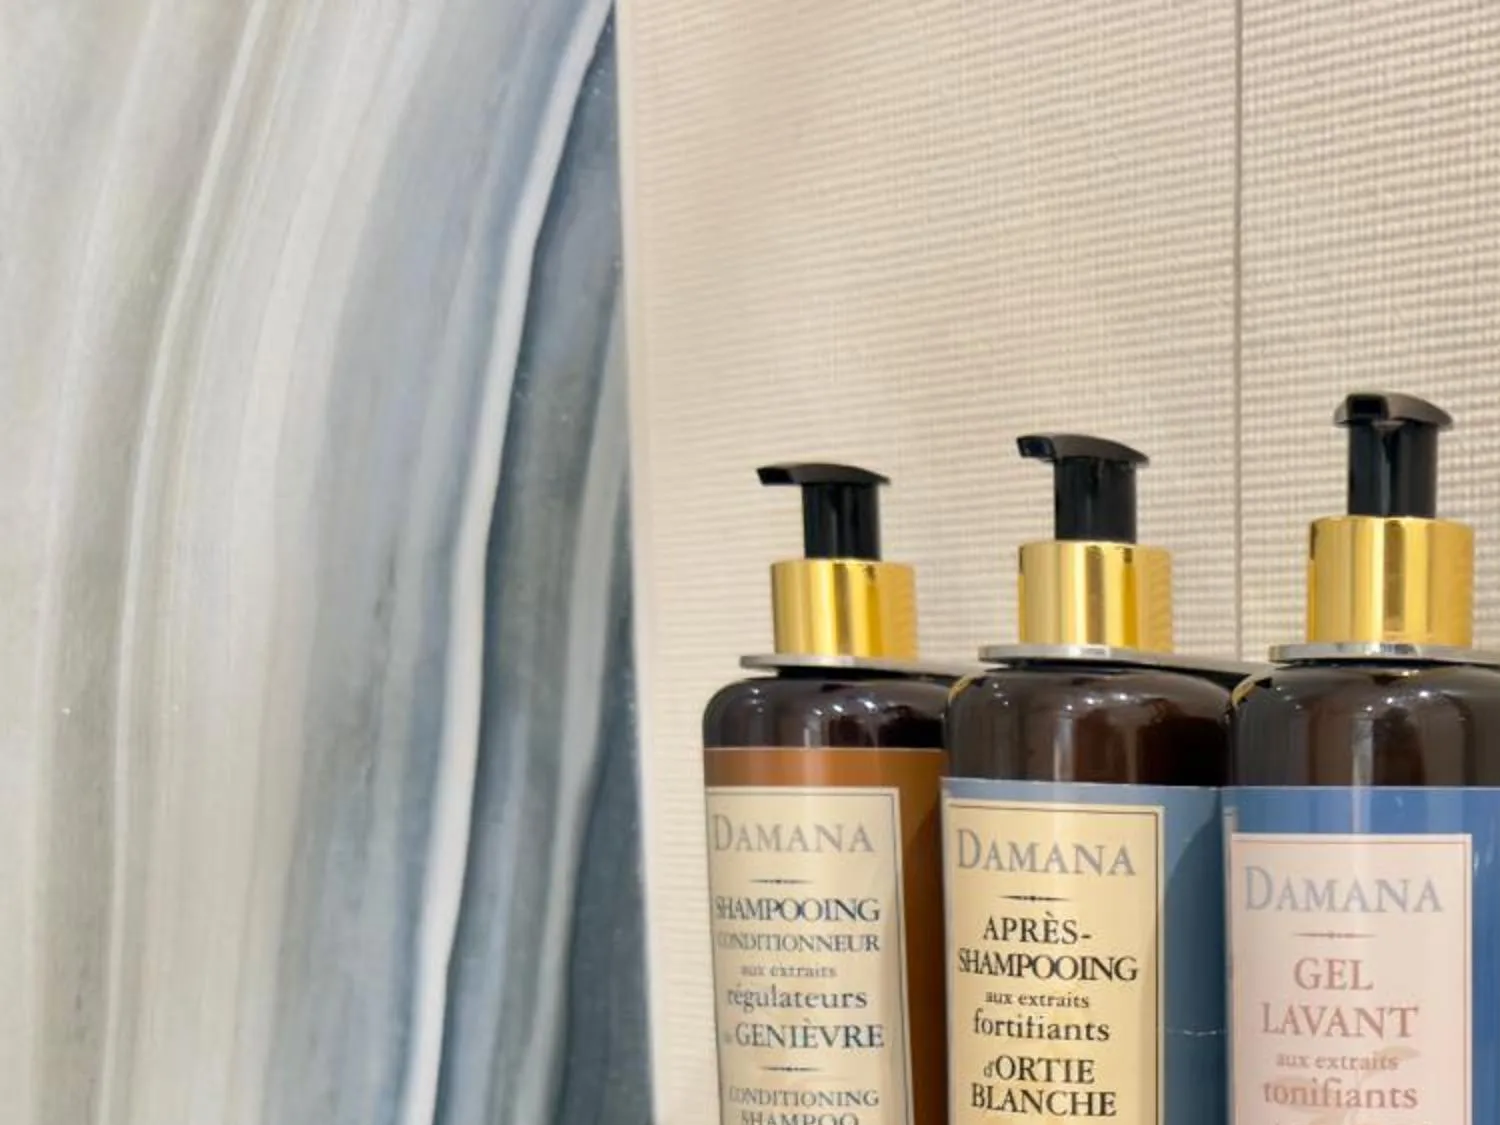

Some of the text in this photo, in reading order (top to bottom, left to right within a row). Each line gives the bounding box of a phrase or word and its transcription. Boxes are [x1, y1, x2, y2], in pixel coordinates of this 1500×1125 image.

[713, 814, 874, 853] DAMANA
[957, 829, 1136, 876] DAMANA
[1244, 865, 1443, 914] DAMANA
[716, 896, 881, 922] SHAMPOOING
[983, 911, 1092, 945] APRÈS-
[741, 963, 837, 978] aux extraits
[958, 947, 1139, 982] SHAMPOOING
[1293, 957, 1374, 991] GEL
[727, 983, 868, 1013] régulateurs
[985, 991, 1090, 1009] aux extraits
[736, 1018, 884, 1048] GENIÈVRE
[973, 1008, 1110, 1042] fortifiants
[1262, 1002, 1420, 1039] LAVANT
[1276, 1051, 1400, 1071] aux extraits
[970, 1082, 1117, 1117] BLANCHE
[1263, 1077, 1419, 1110] tonifiants
